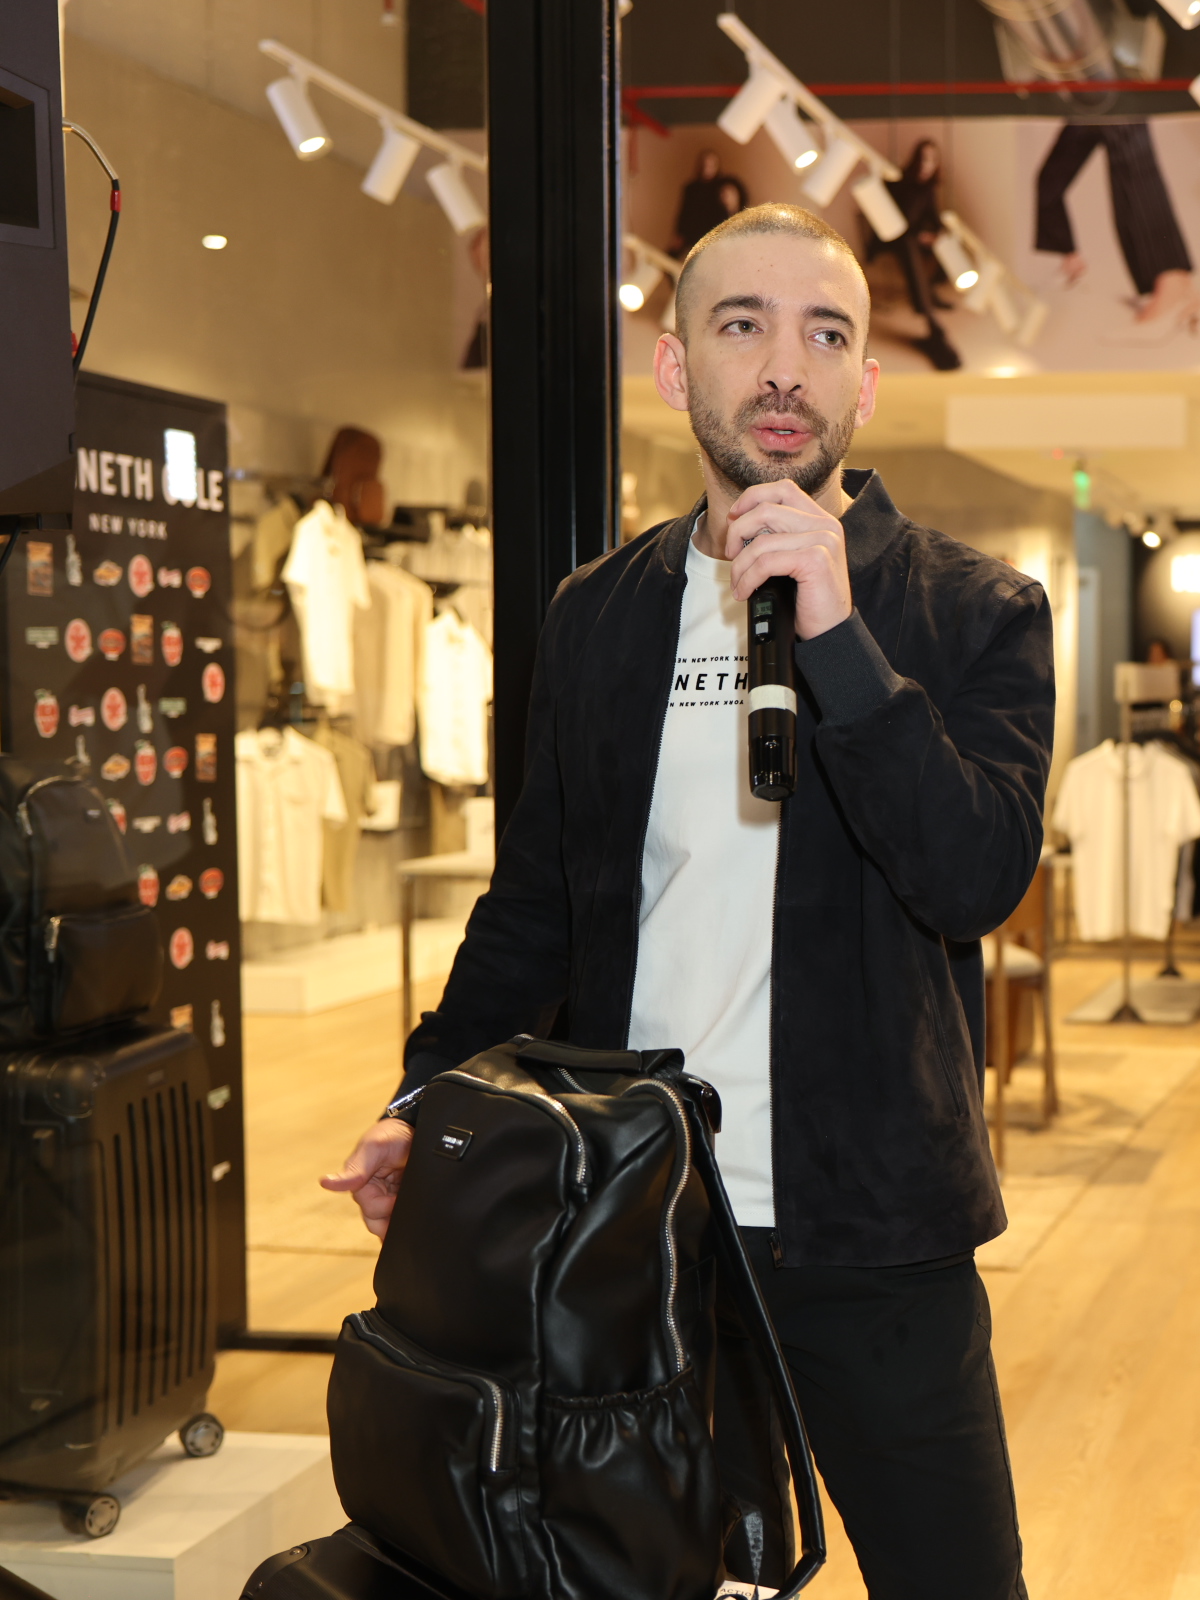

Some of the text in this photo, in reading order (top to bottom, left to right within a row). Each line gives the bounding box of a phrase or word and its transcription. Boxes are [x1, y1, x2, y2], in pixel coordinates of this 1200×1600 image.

[76, 447, 225, 512] NETH LE
[89, 513, 168, 540] NEW YORK
[674, 672, 748, 690] NETH
[720, 1588, 752, 1597] ACTIO
